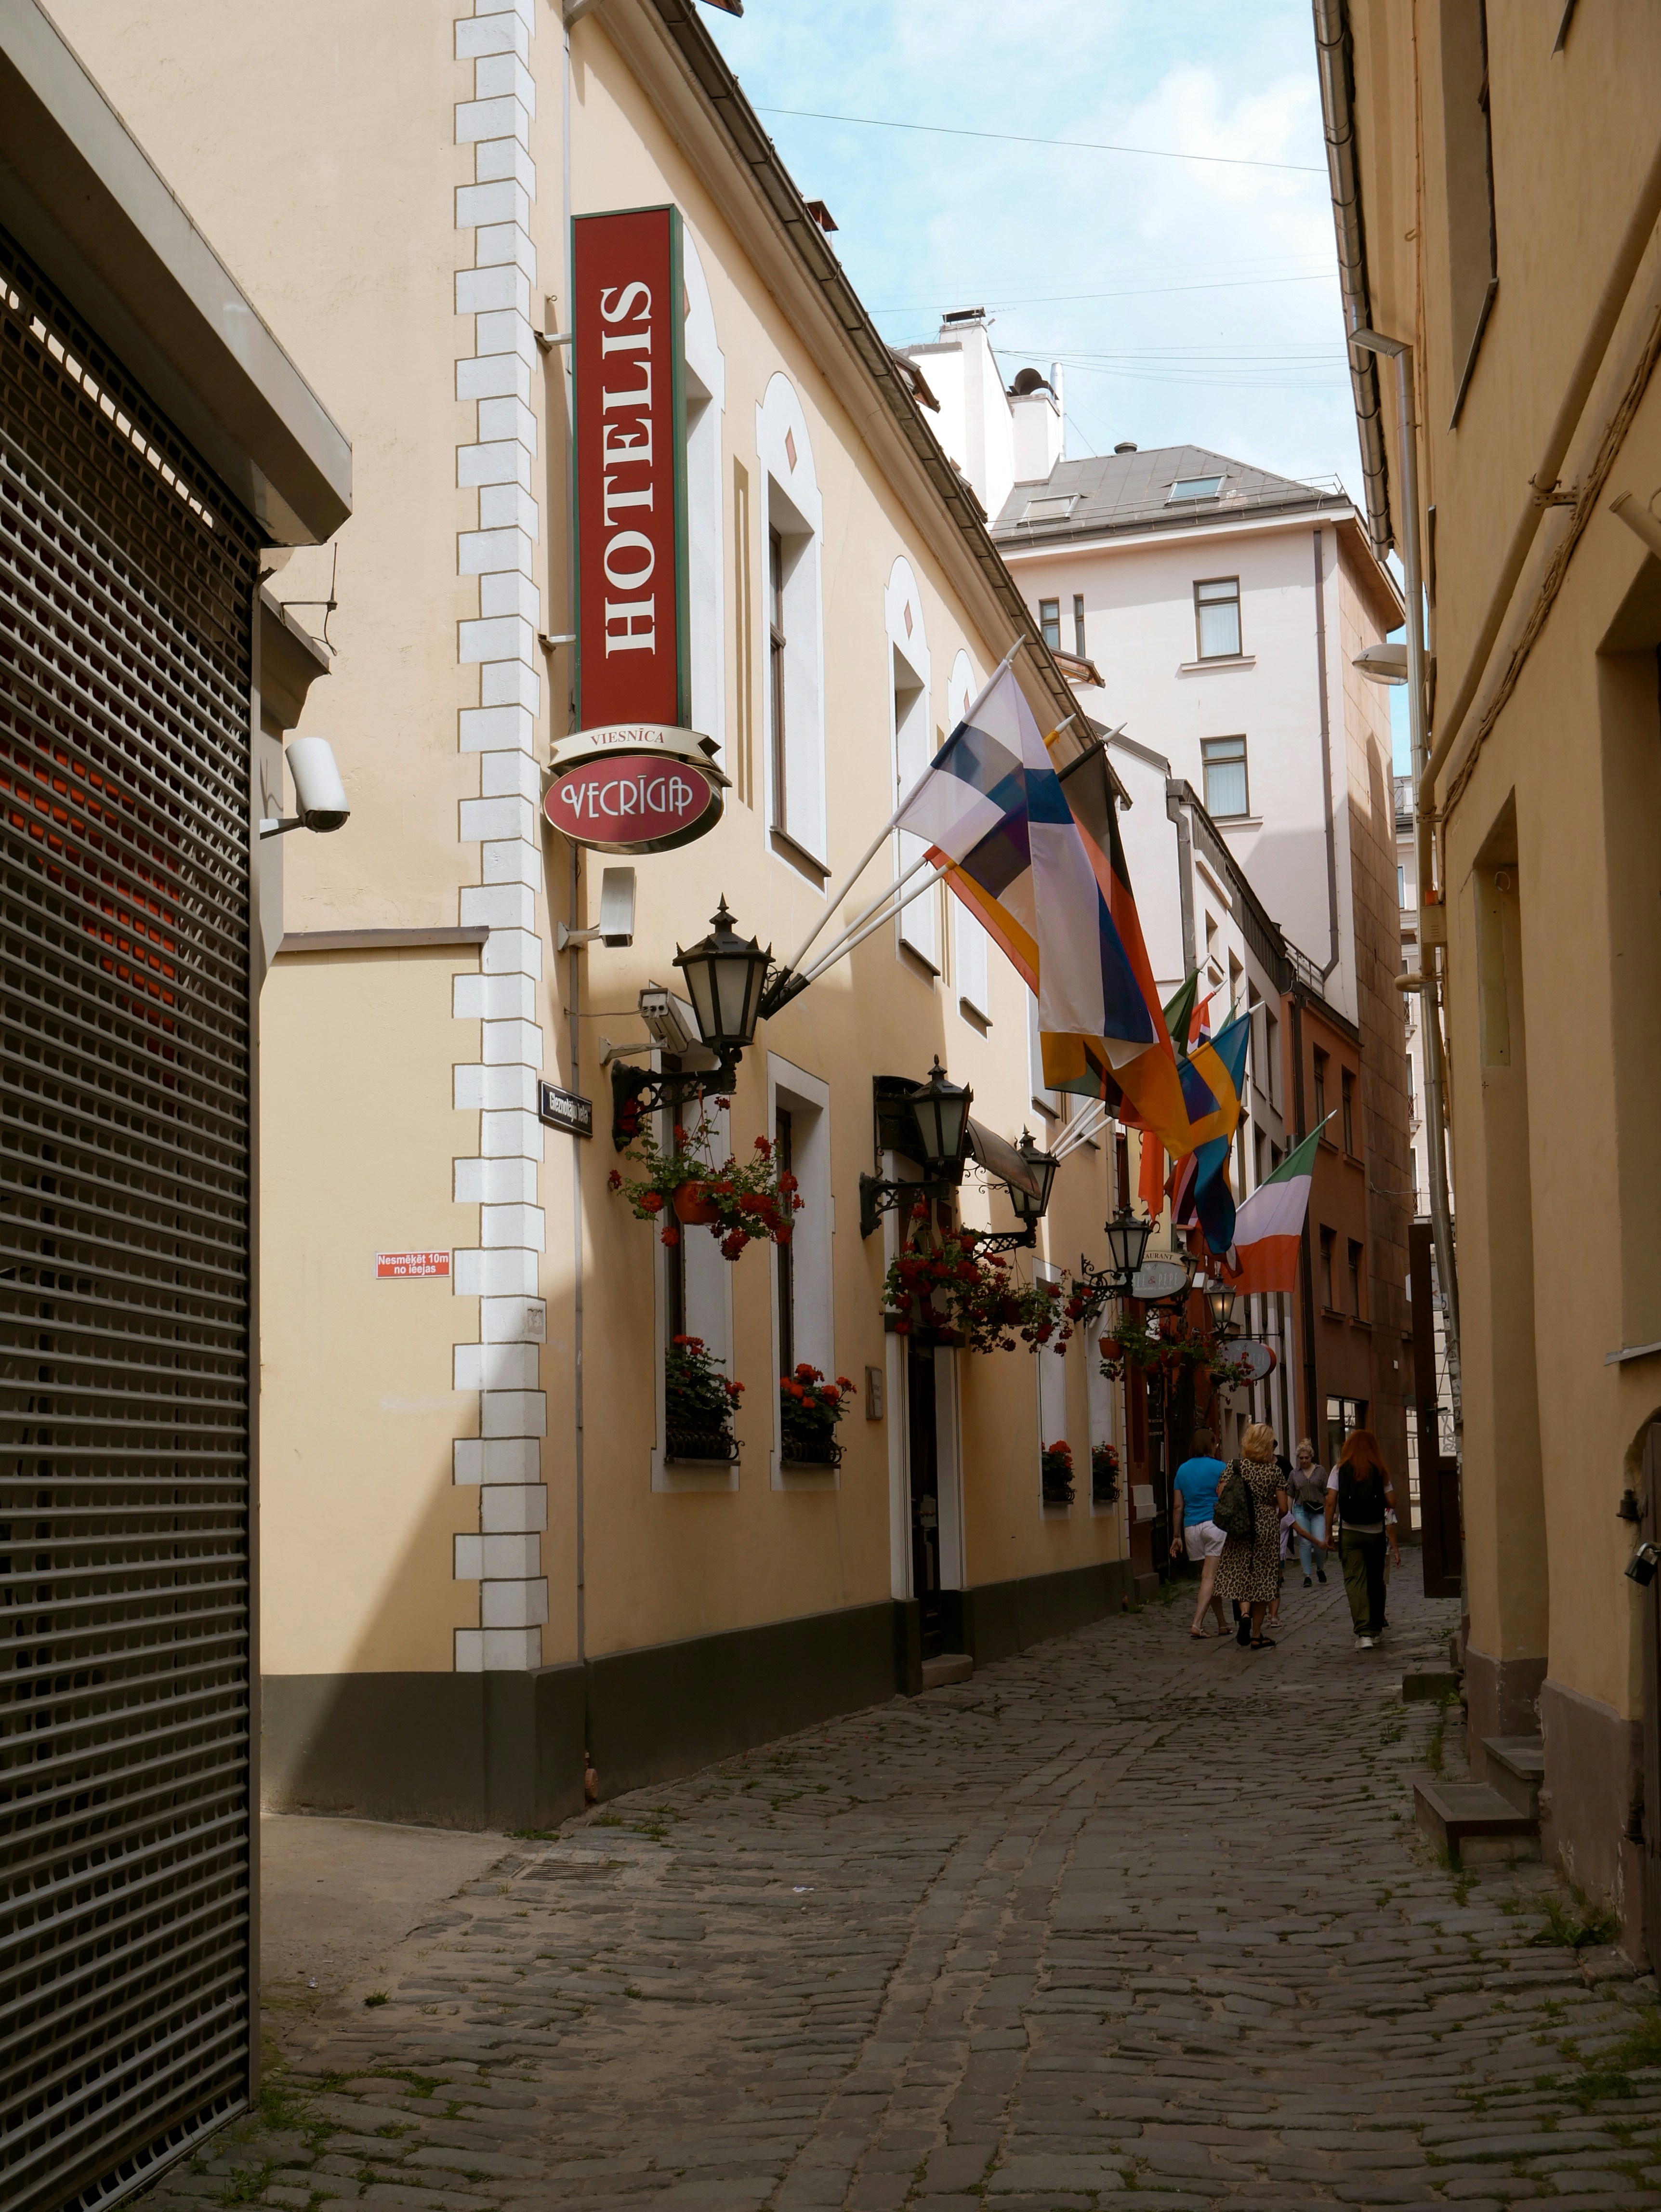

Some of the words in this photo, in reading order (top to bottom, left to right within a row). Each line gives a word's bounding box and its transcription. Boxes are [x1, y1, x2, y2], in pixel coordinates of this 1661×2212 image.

[600, 281, 656, 659] HOTELIS
[591, 728, 665, 746] VIESNĪCA
[561, 775, 694, 819] VECRĪGA
[549, 1091, 577, 1123] Gleznotāju
[577, 1102, 588, 1124] iela
[378, 1254, 426, 1265] Nesmēķēt
[429, 1253, 448, 1264] 10m
[409, 1264, 436, 1276] ieejas
[1148, 1276, 1155, 1284] &
[1159, 1273, 1177, 1286] PEPE
